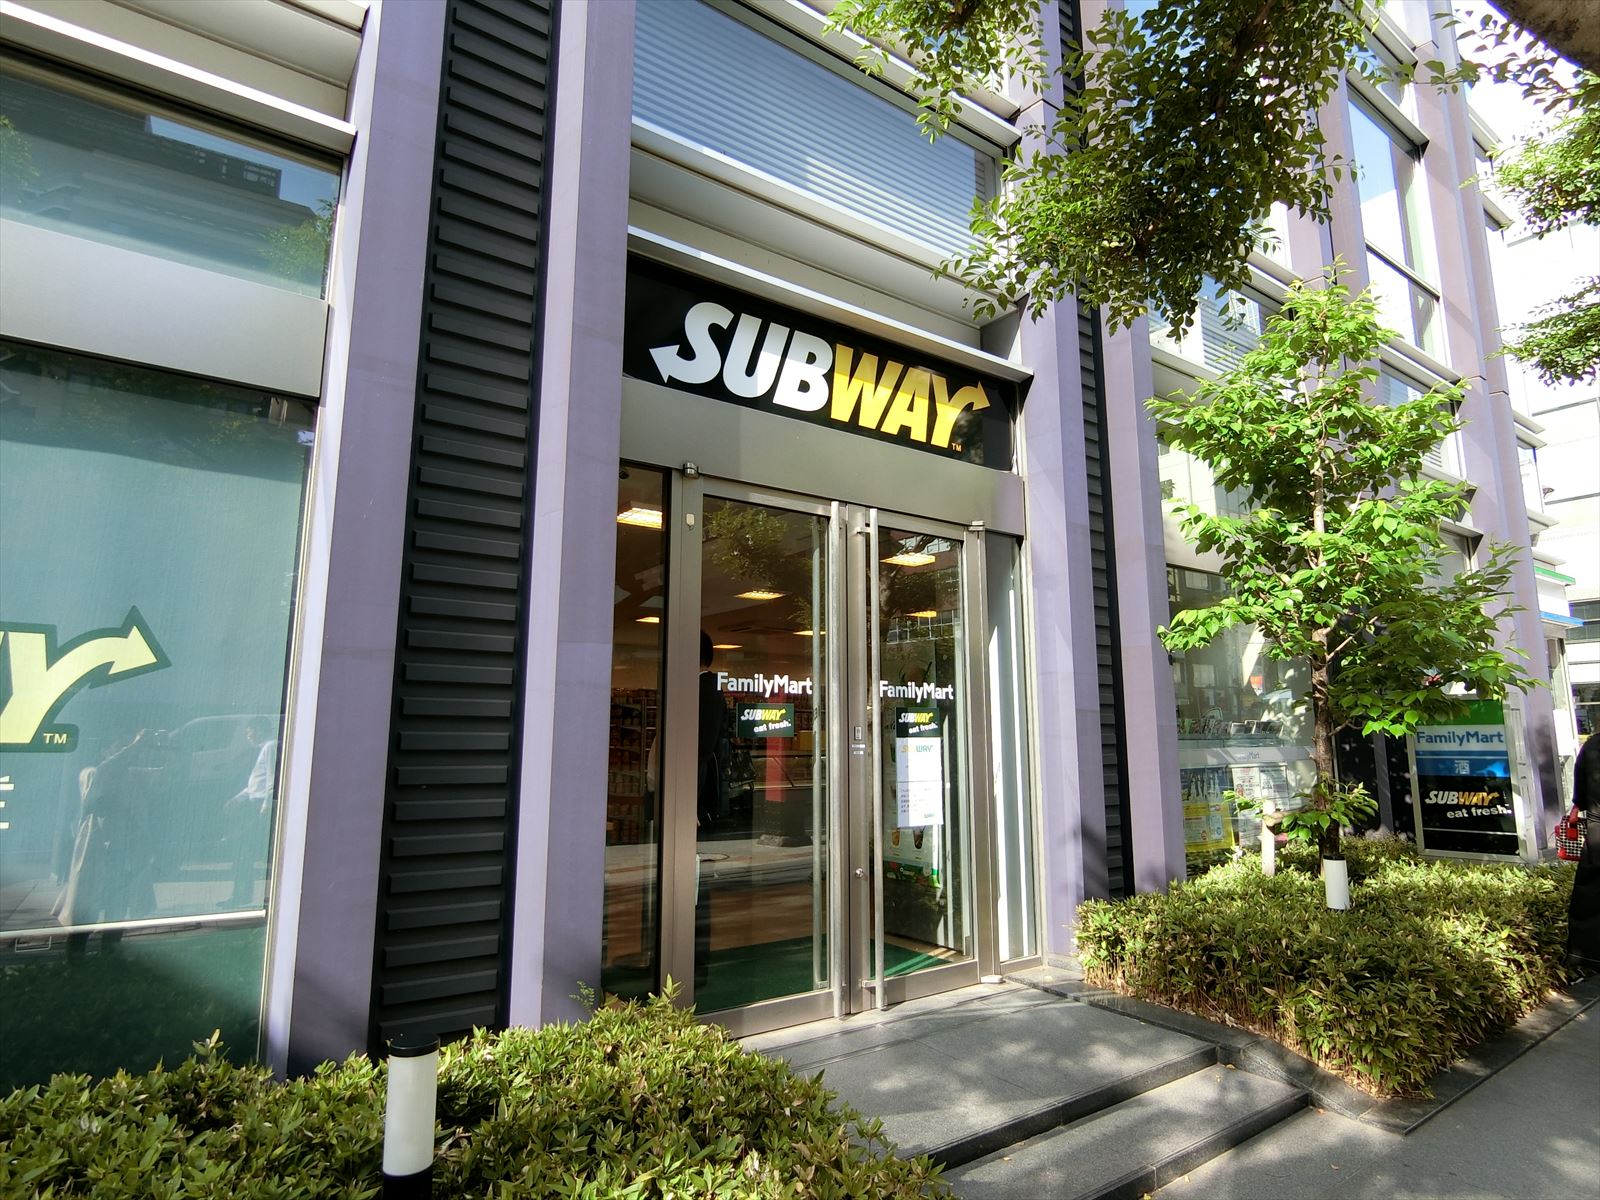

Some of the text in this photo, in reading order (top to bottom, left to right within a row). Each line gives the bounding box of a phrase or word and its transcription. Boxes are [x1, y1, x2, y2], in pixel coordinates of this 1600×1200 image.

[649, 302, 991, 449] SUBWAY
[716, 671, 813, 698] FamilyMart
[879, 679, 954, 703] FamilyMart
[740, 708, 786, 721] SUBWAY
[898, 712, 934, 724] SUBWAY
[753, 725, 768, 733] eat
[43, 733, 68, 745] TM
[1416, 731, 1504, 746] FamilyMart
[900, 744, 934, 753] SWAY
[1425, 791, 1499, 805] SUBWAY
[1447, 808, 1468, 819] eat
